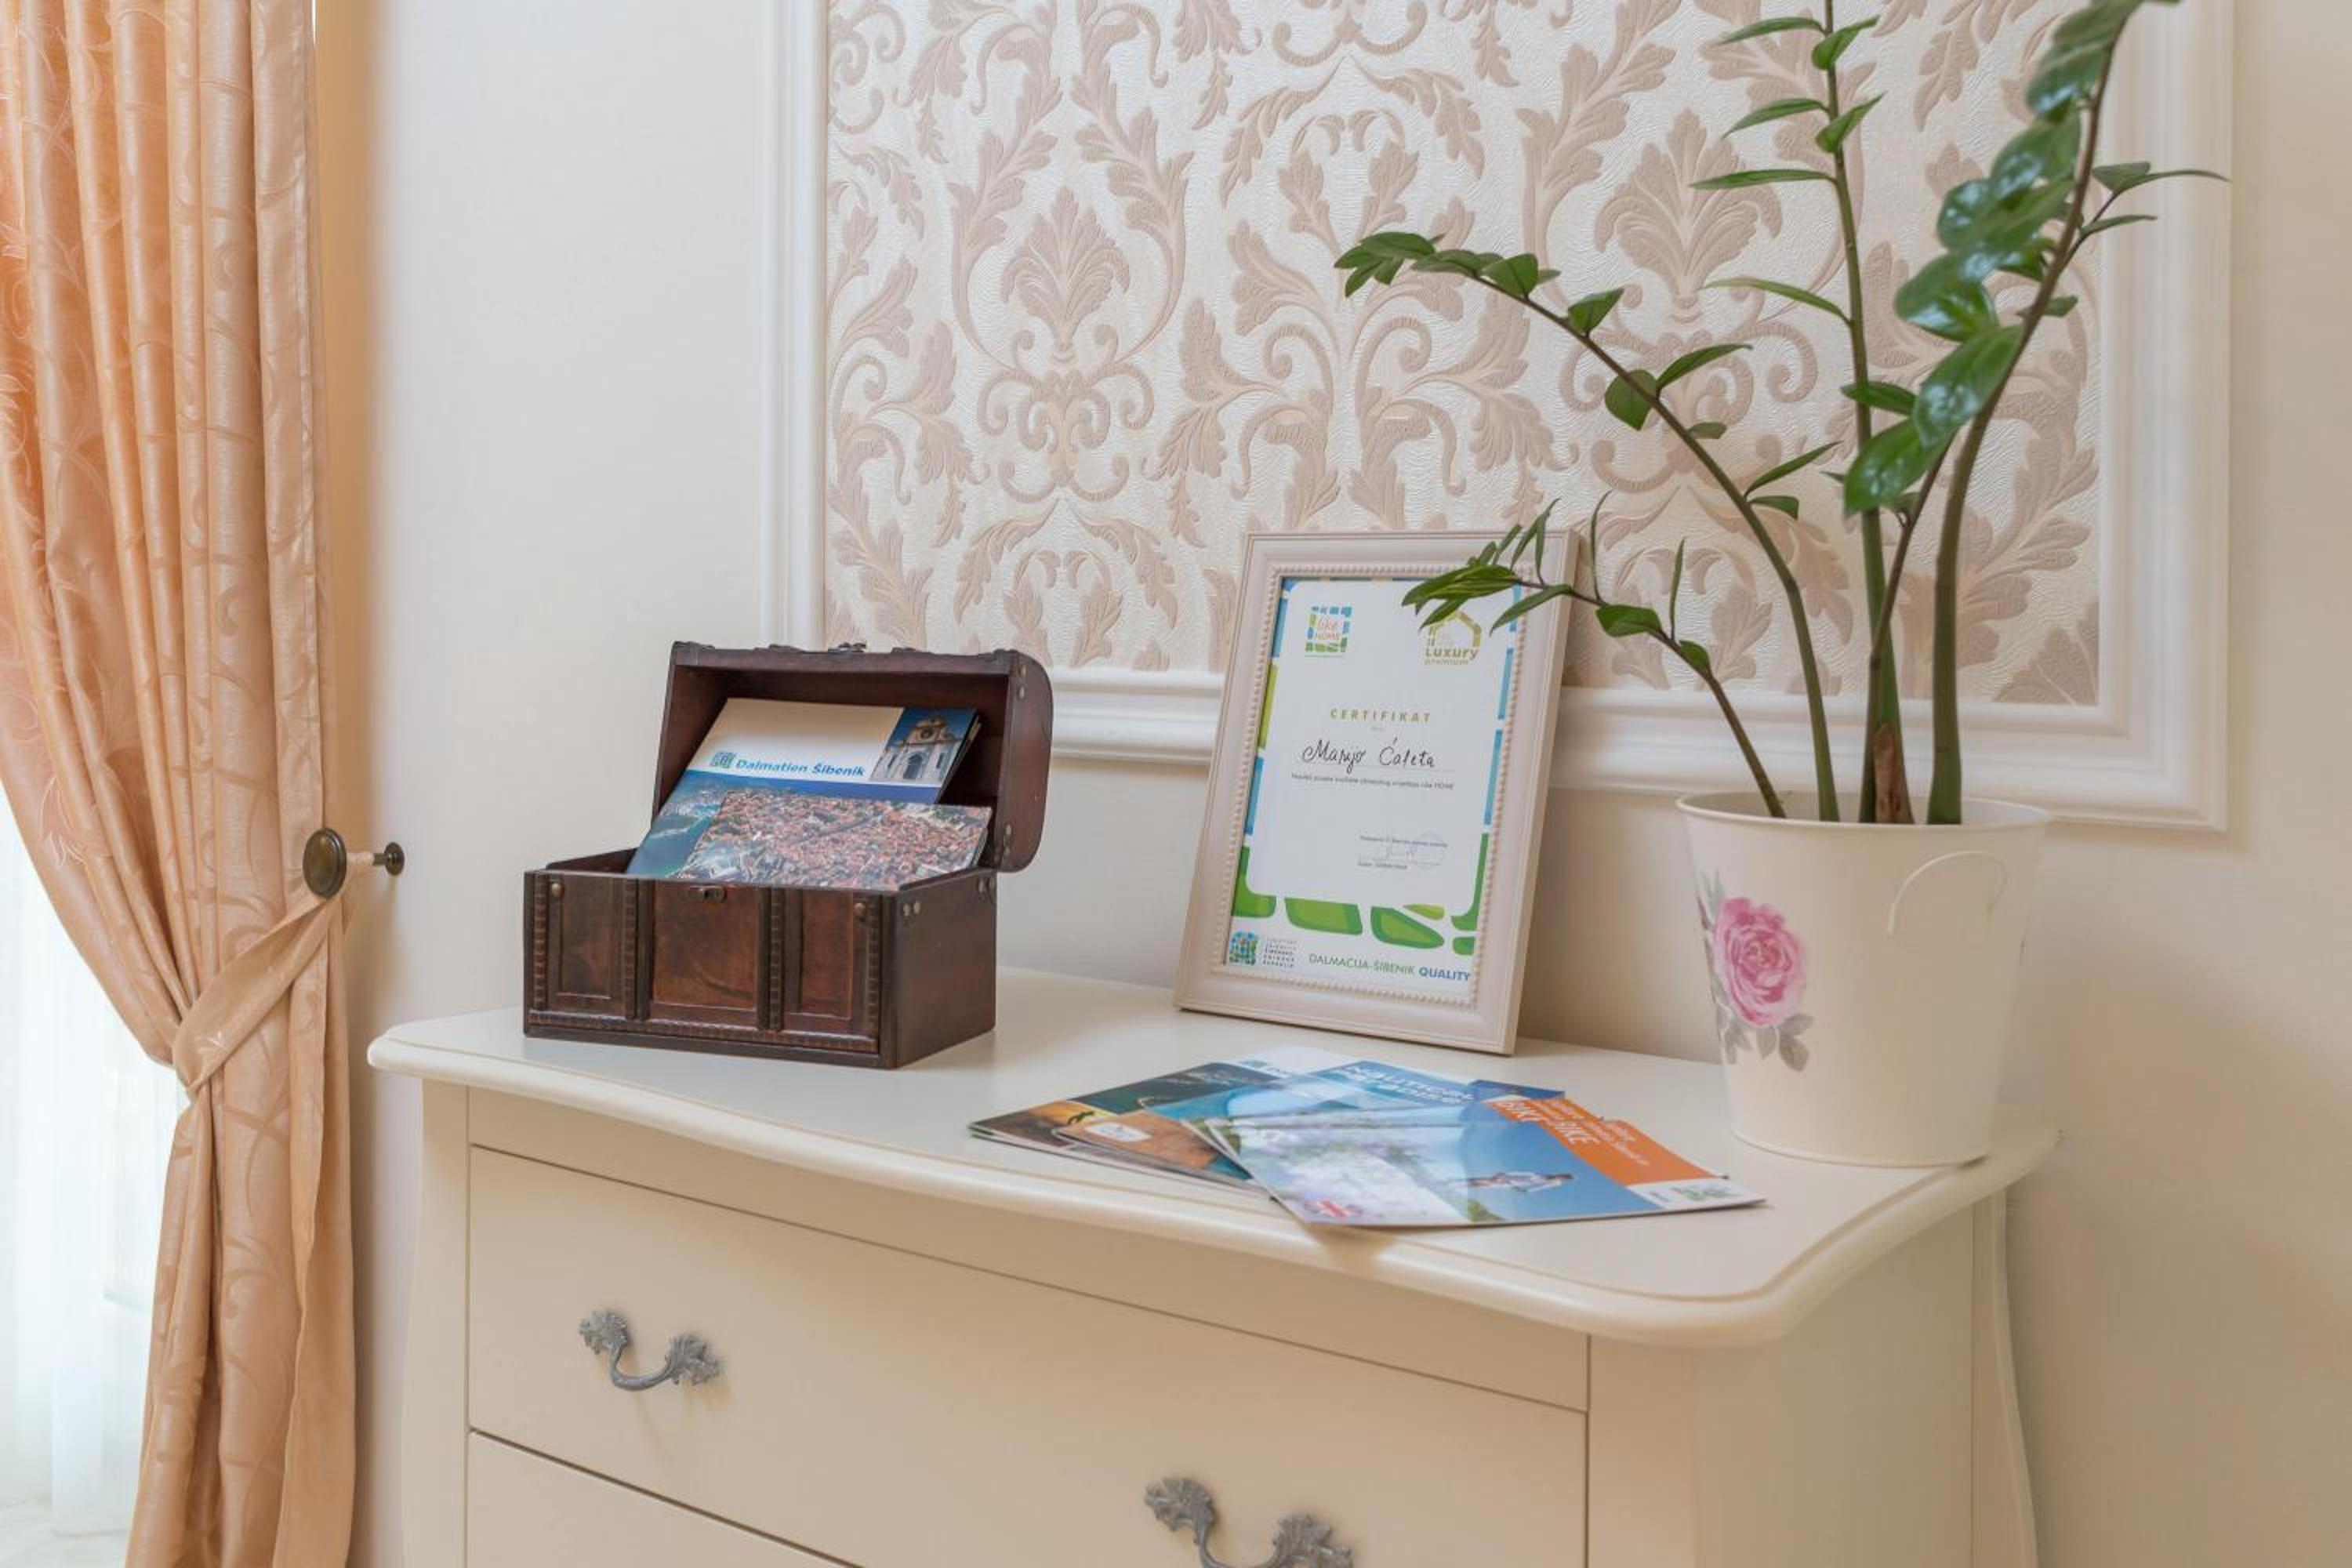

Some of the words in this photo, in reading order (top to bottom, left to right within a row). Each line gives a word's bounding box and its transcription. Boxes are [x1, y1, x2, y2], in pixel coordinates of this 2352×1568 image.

[1330, 708, 1431, 724] CERTIFIKAT
[735, 758, 808, 774] Dalmatien
[811, 761, 866, 776] Šibenik
[1418, 966, 1471, 982] QUALITY
